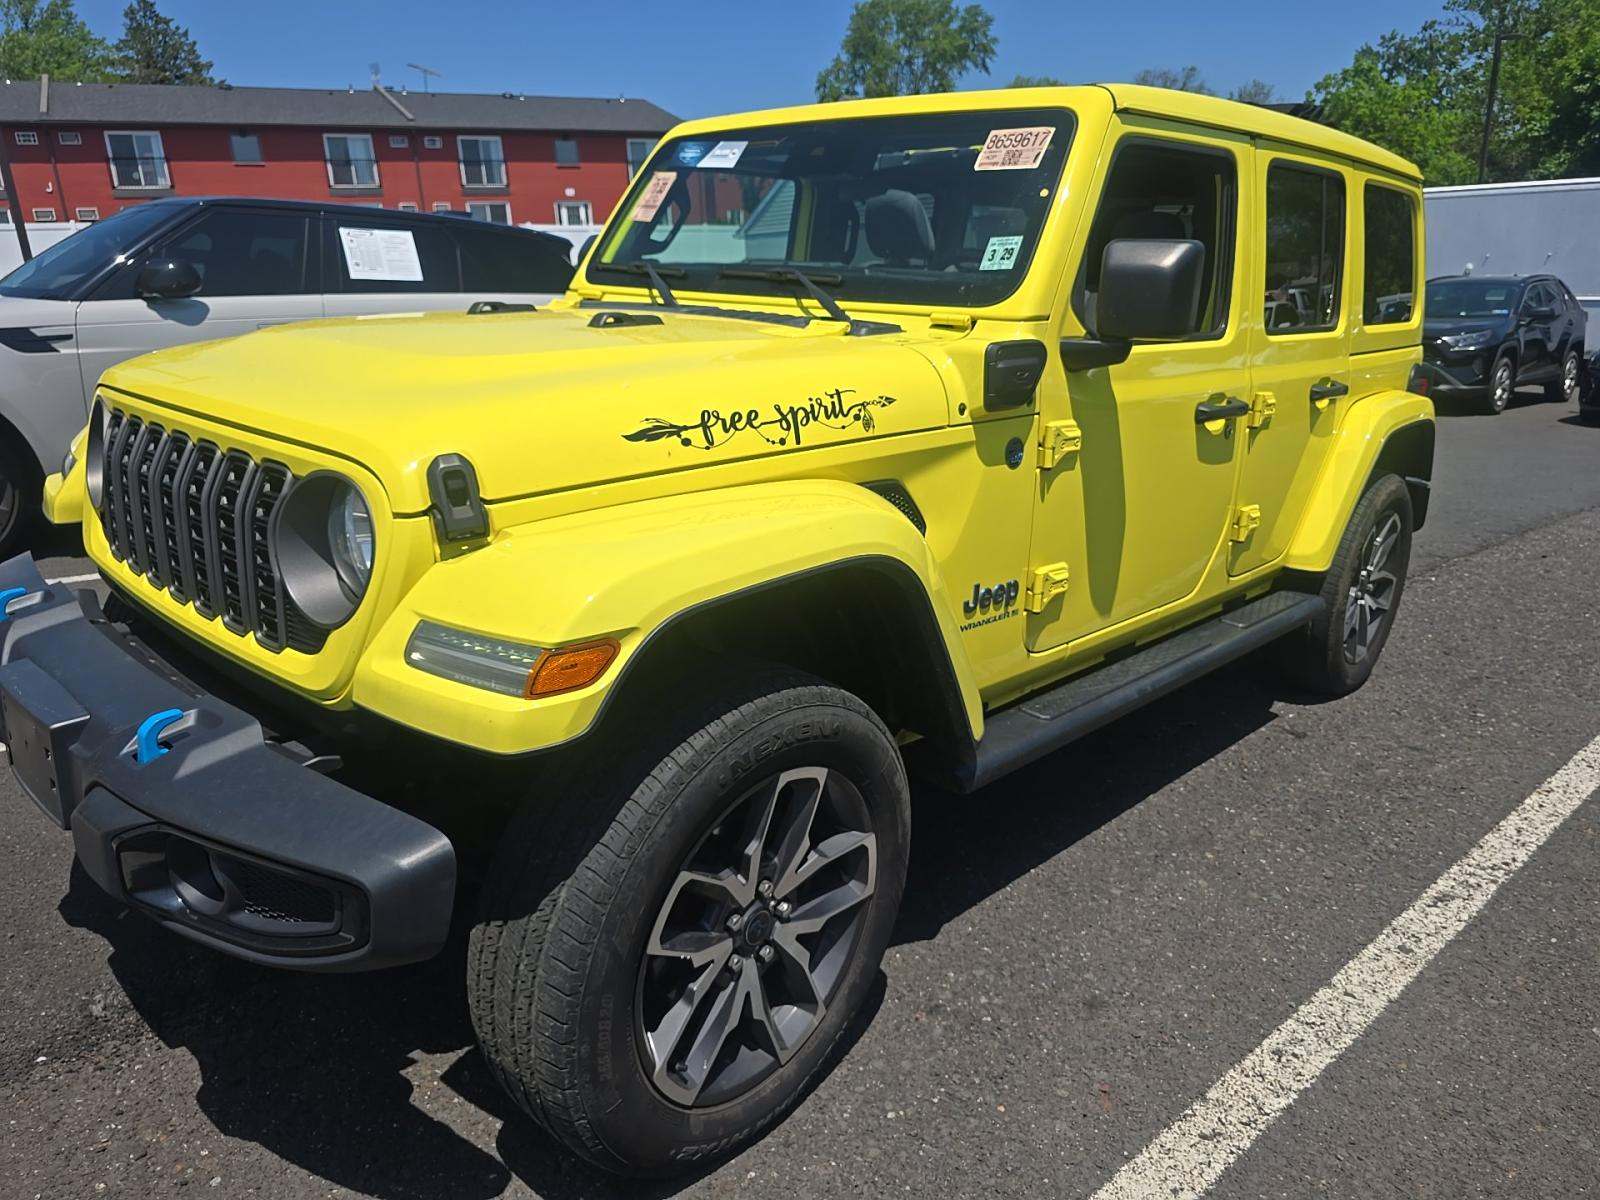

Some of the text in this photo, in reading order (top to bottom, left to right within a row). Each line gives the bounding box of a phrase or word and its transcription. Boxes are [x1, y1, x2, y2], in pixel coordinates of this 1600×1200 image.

[986, 130, 1051, 149] 8659617
[987, 247, 1014, 262] 3 29
[700, 388, 857, 446] free spirit
[963, 580, 1019, 614] Jeep
[960, 612, 1010, 632] WRANGLER
